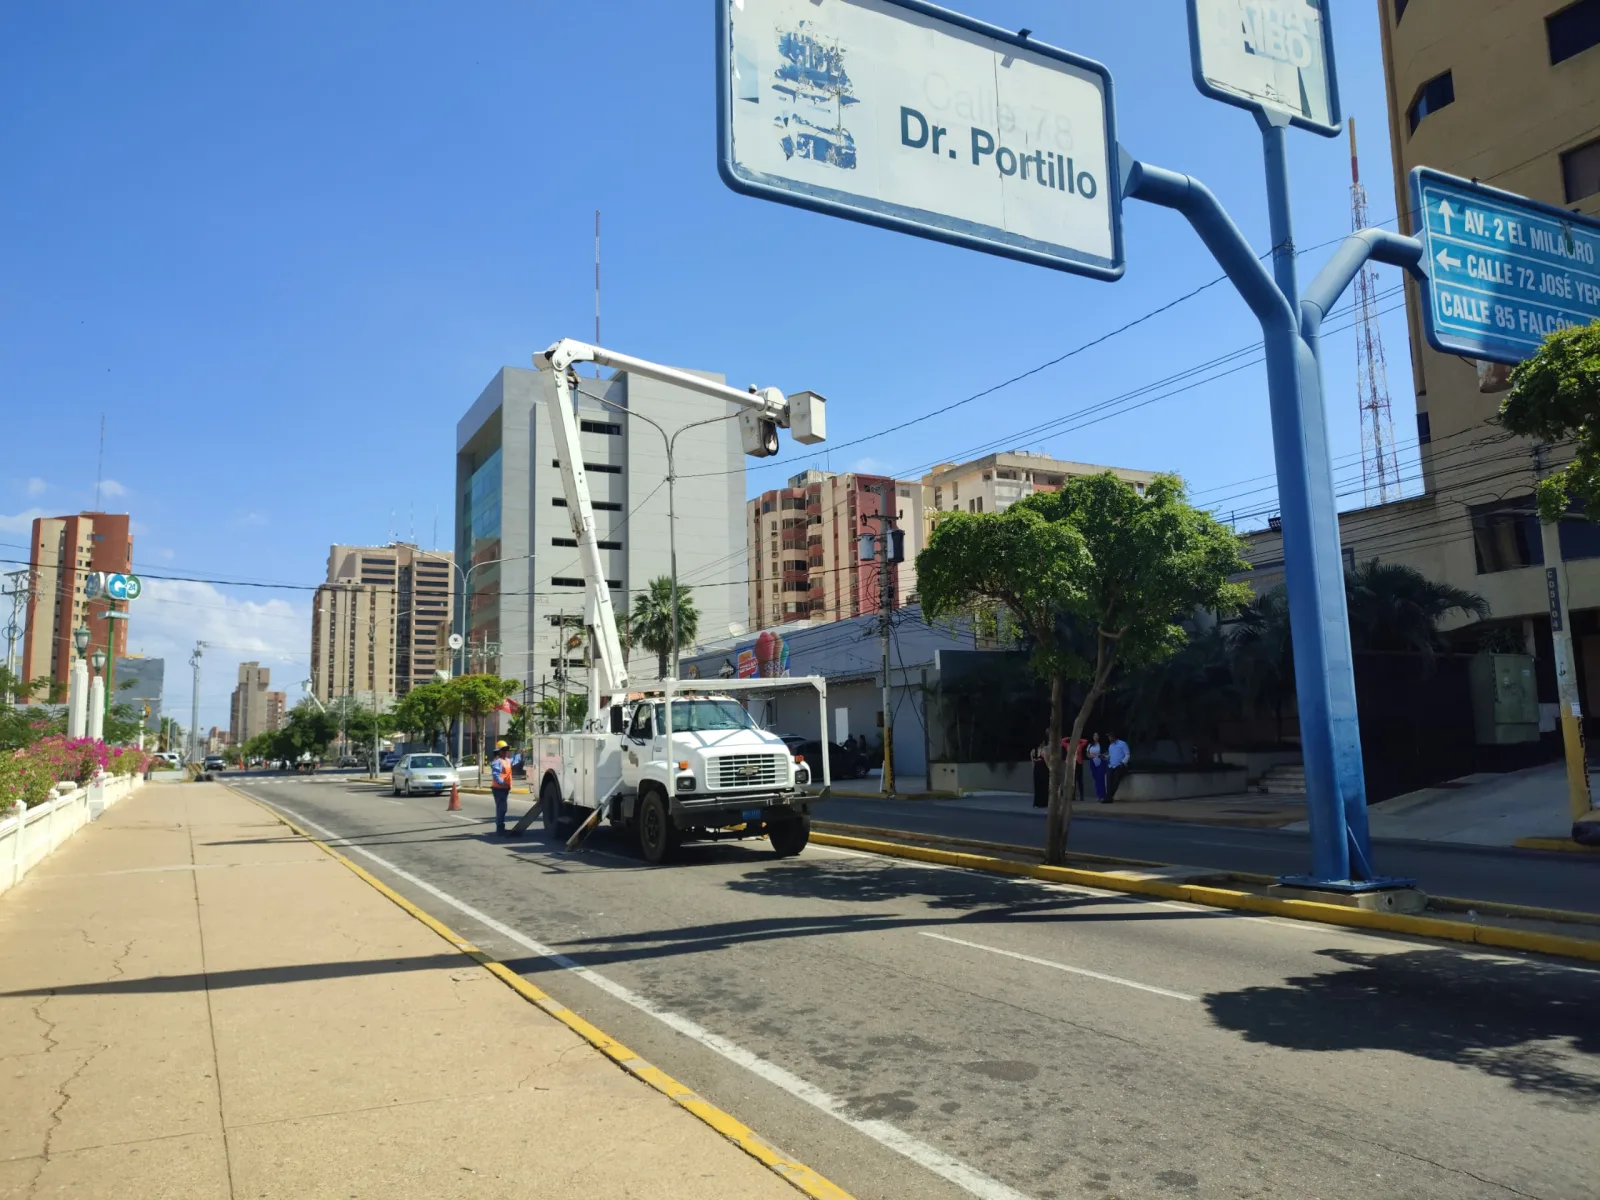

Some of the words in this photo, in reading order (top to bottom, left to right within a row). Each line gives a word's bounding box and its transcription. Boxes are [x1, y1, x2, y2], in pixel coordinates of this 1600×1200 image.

[1030, 103, 1074, 151] 78
[900, 104, 958, 159] Dr.
[970, 125, 1097, 199] Portillo
[1464, 209, 1490, 238] AV.
[1493, 218, 1505, 242] 2
[1508, 221, 1527, 247] EL
[1467, 254, 1514, 286] CALLE
[1517, 267, 1536, 291] 72
[1539, 273, 1573, 299] JOSÉ
[1440, 292, 1492, 325] CALLE
[1495, 304, 1515, 330] 85
